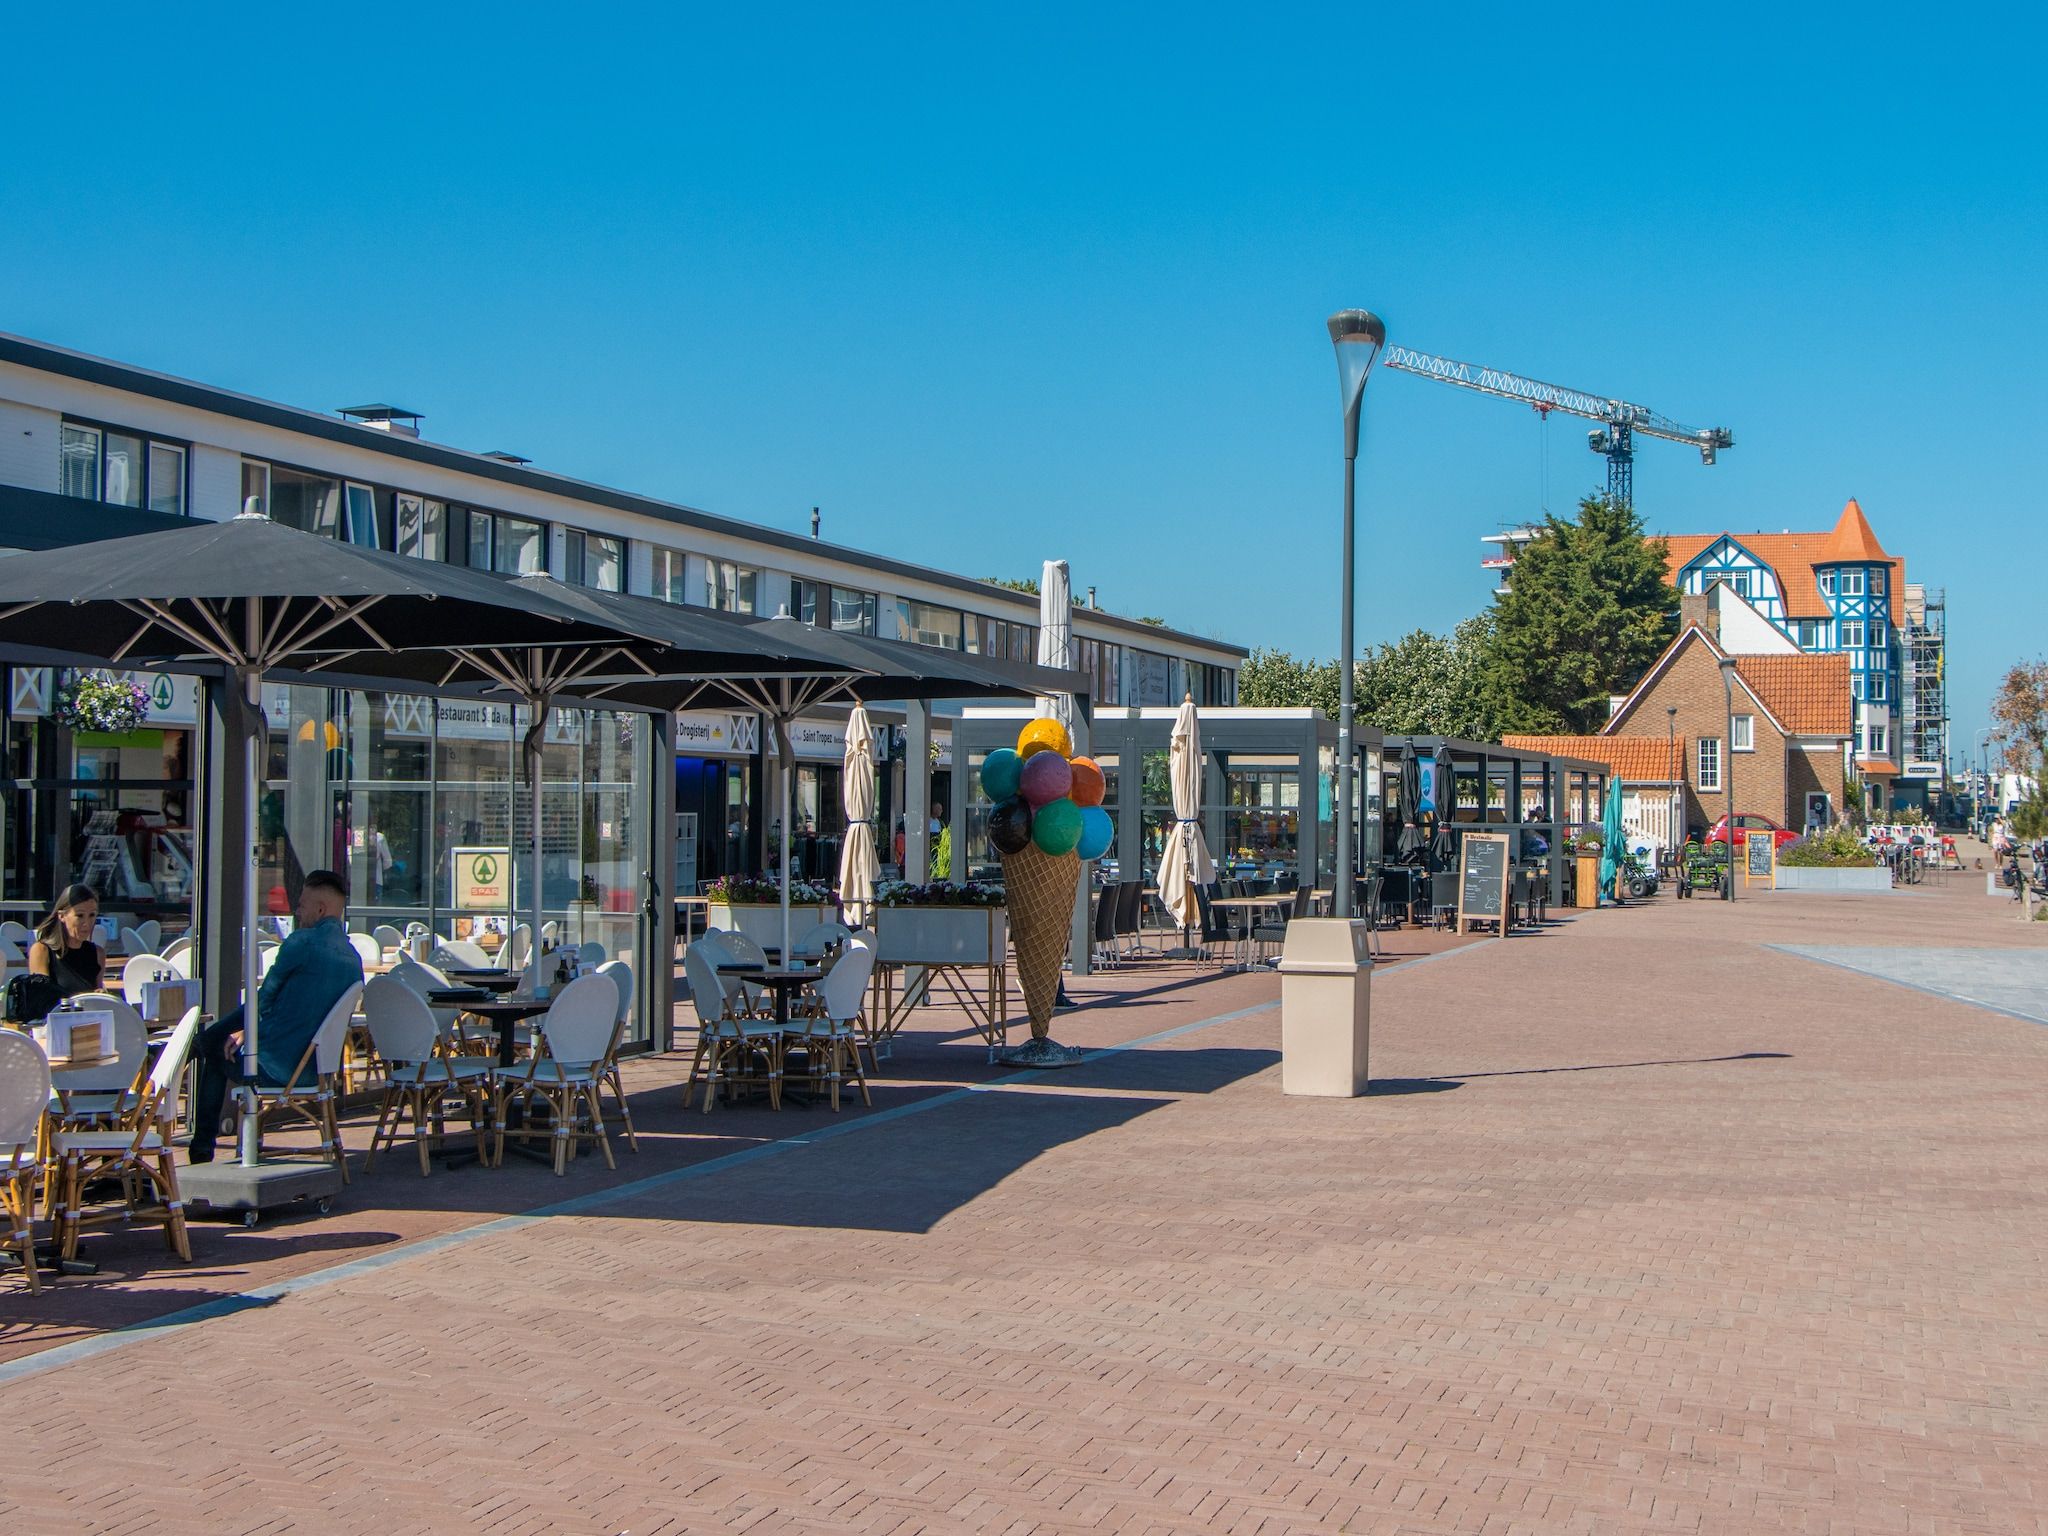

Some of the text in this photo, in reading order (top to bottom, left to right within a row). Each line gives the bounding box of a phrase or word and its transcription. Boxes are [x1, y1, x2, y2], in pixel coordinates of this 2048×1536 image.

[482, 706, 501, 723] Sda
[680, 722, 710, 741] Drogisterij
[803, 729, 816, 743] Saint
[816, 730, 833, 746] Tropez
